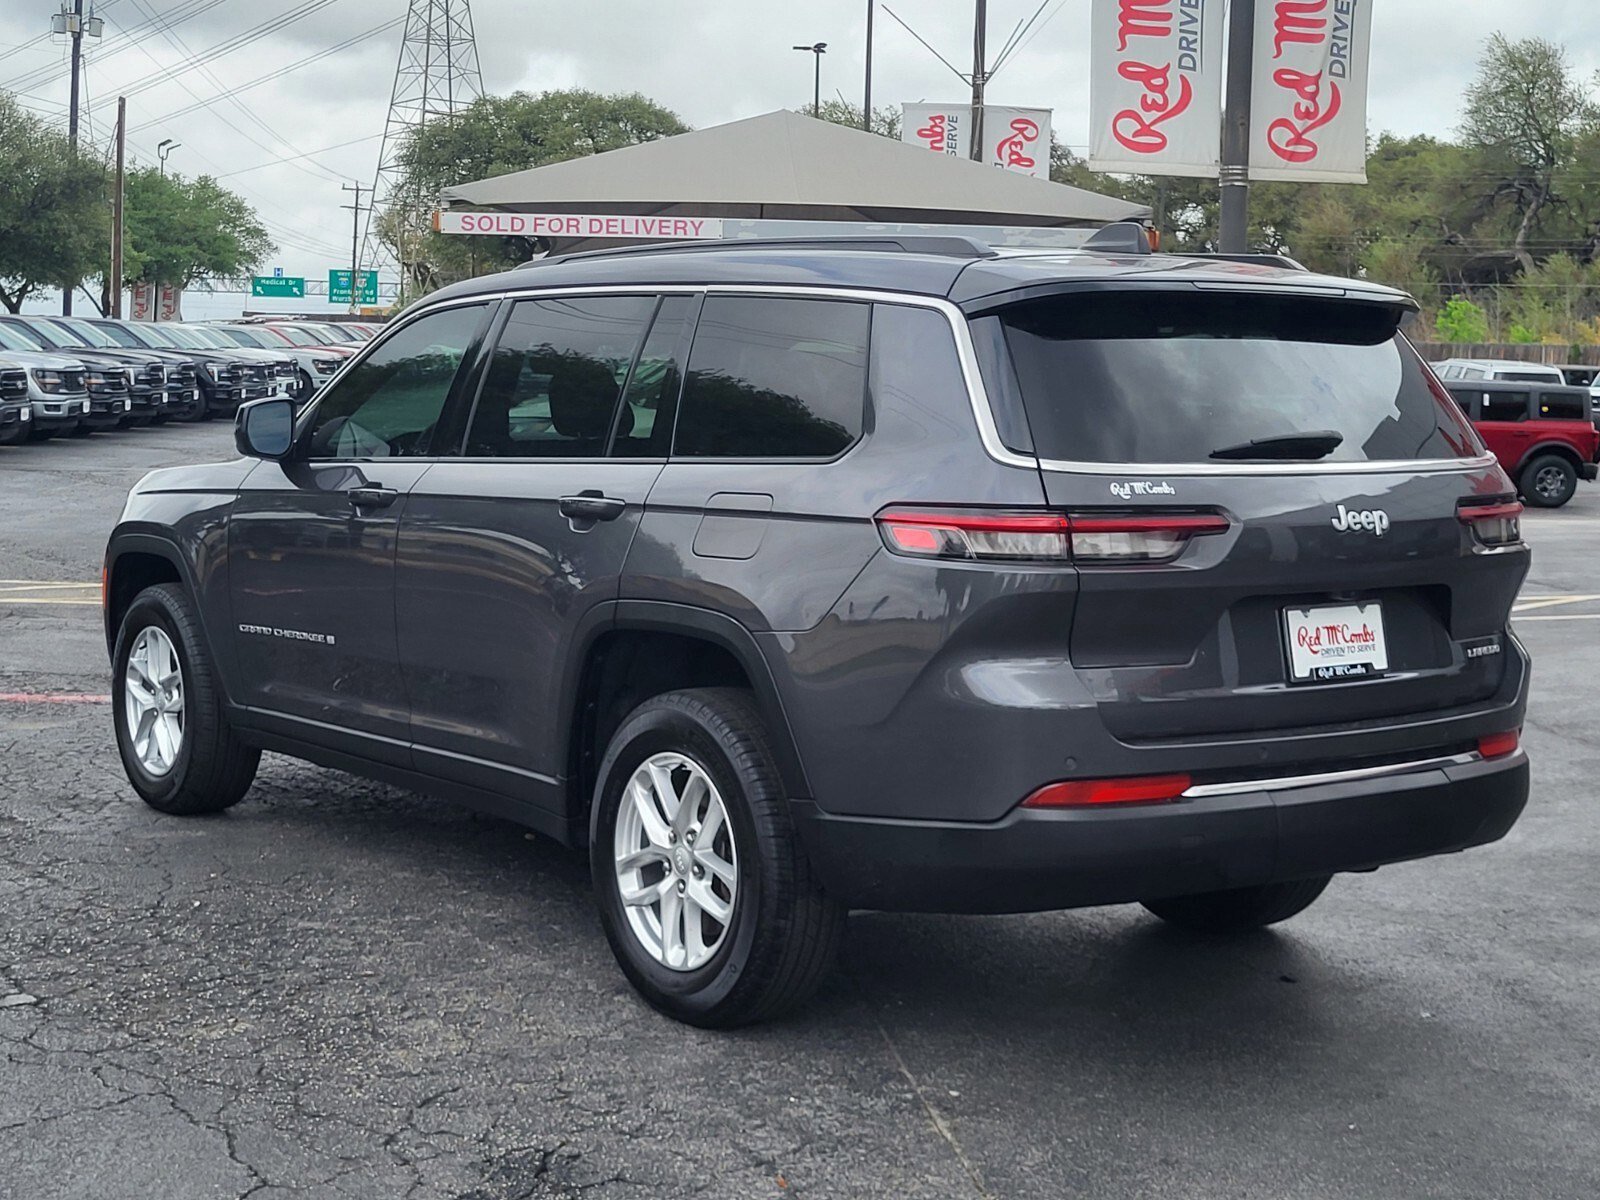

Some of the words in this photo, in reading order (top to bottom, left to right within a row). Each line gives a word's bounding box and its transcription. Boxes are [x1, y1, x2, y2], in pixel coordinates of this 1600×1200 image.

[1329, 0, 1351, 78] DRIVE
[1112, 60, 1192, 154] Red
[1267, 68, 1341, 163] Red
[997, 118, 1039, 168] Red
[461, 215, 525, 232] SOLD
[533, 217, 581, 234] FOR
[588, 218, 704, 236] DELIVERY
[1110, 482, 1132, 499] Red
[1331, 504, 1389, 536] Jeep
[239, 624, 272, 635] GRAND
[273, 628, 325, 643] CHEROKEE
[1298, 626, 1322, 655] Red
[1322, 623, 1375, 645] McCombs
[1321, 647, 1345, 656] DRIVEN
[1347, 645, 1355, 654] TO
[1357, 644, 1376, 653] SERVE
